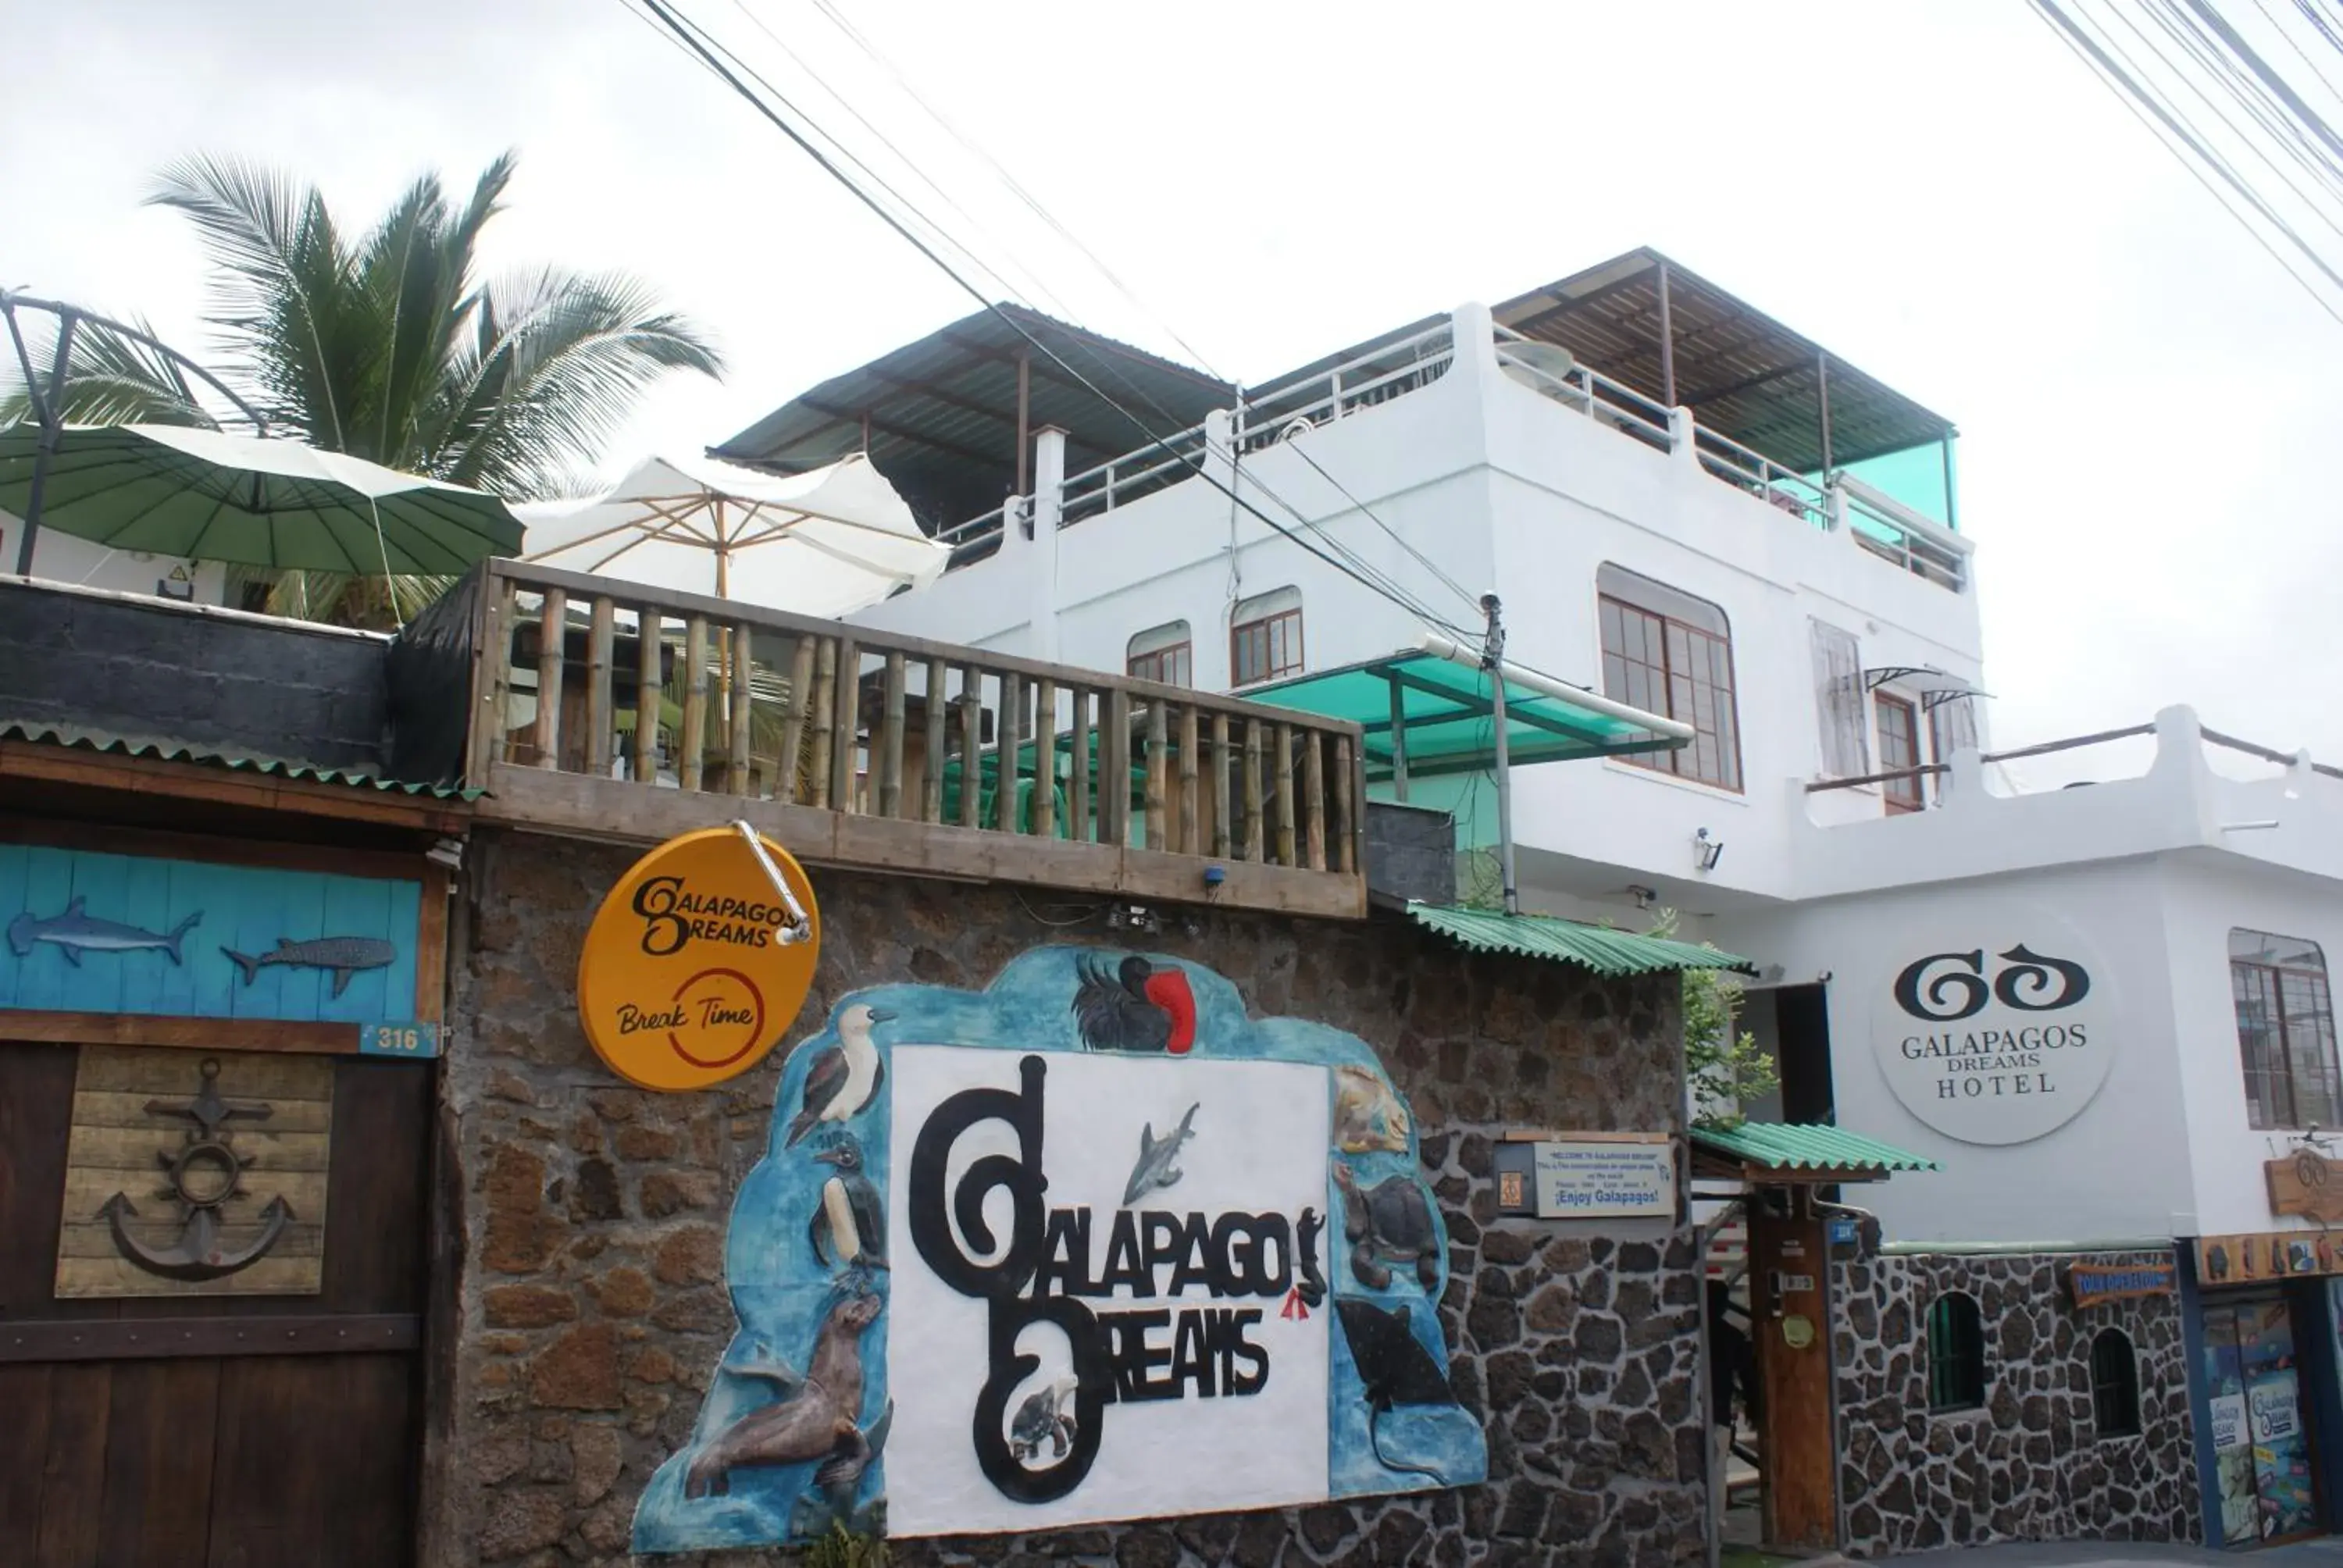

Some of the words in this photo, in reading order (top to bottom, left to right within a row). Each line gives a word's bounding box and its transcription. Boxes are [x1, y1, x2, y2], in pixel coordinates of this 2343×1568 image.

[641, 912, 771, 957] DREAMS
[617, 1003, 688, 1035] Break
[697, 996, 754, 1029] Time
[378, 1026, 419, 1050] 316
[1901, 1023, 2088, 1060] GALAPAGOS
[1947, 1053, 2041, 1072] DREAMS
[1936, 1072, 2056, 1099] HOTEL
[1595, 1188, 1659, 1206] Galapagos!
